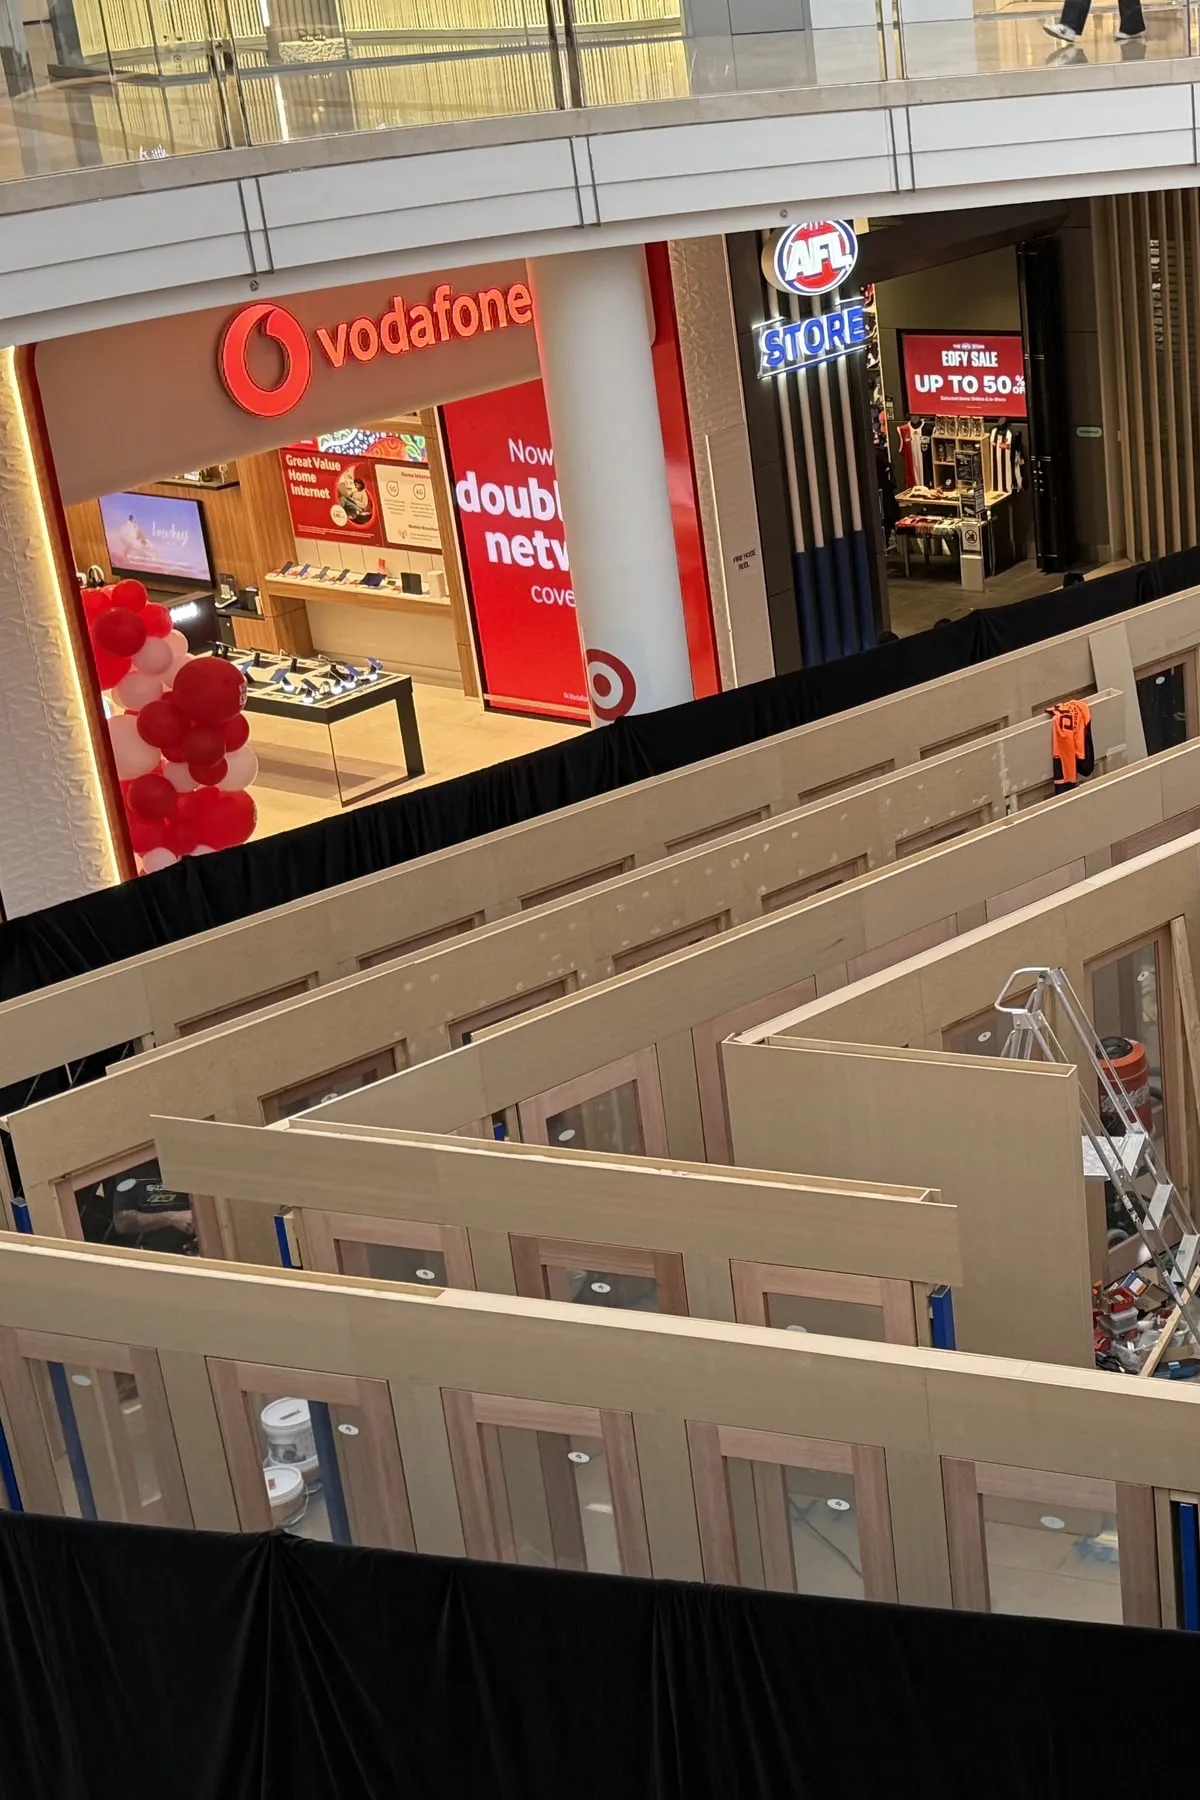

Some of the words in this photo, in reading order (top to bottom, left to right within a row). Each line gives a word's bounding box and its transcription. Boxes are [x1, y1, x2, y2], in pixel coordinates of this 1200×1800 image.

[786, 231, 853, 281] AFL
[316, 283, 533, 368] vodafone
[762, 306, 866, 367] STORE
[941, 350, 968, 367] EOFY
[970, 351, 999, 368] SALE
[914, 374, 944, 393] UP
[948, 374, 979, 394] TO
[508, 438, 554, 466] Now
[286, 454, 313, 469] Great
[312, 456, 342, 471] Value
[287, 469, 317, 483] Home
[290, 483, 331, 499] Internet
